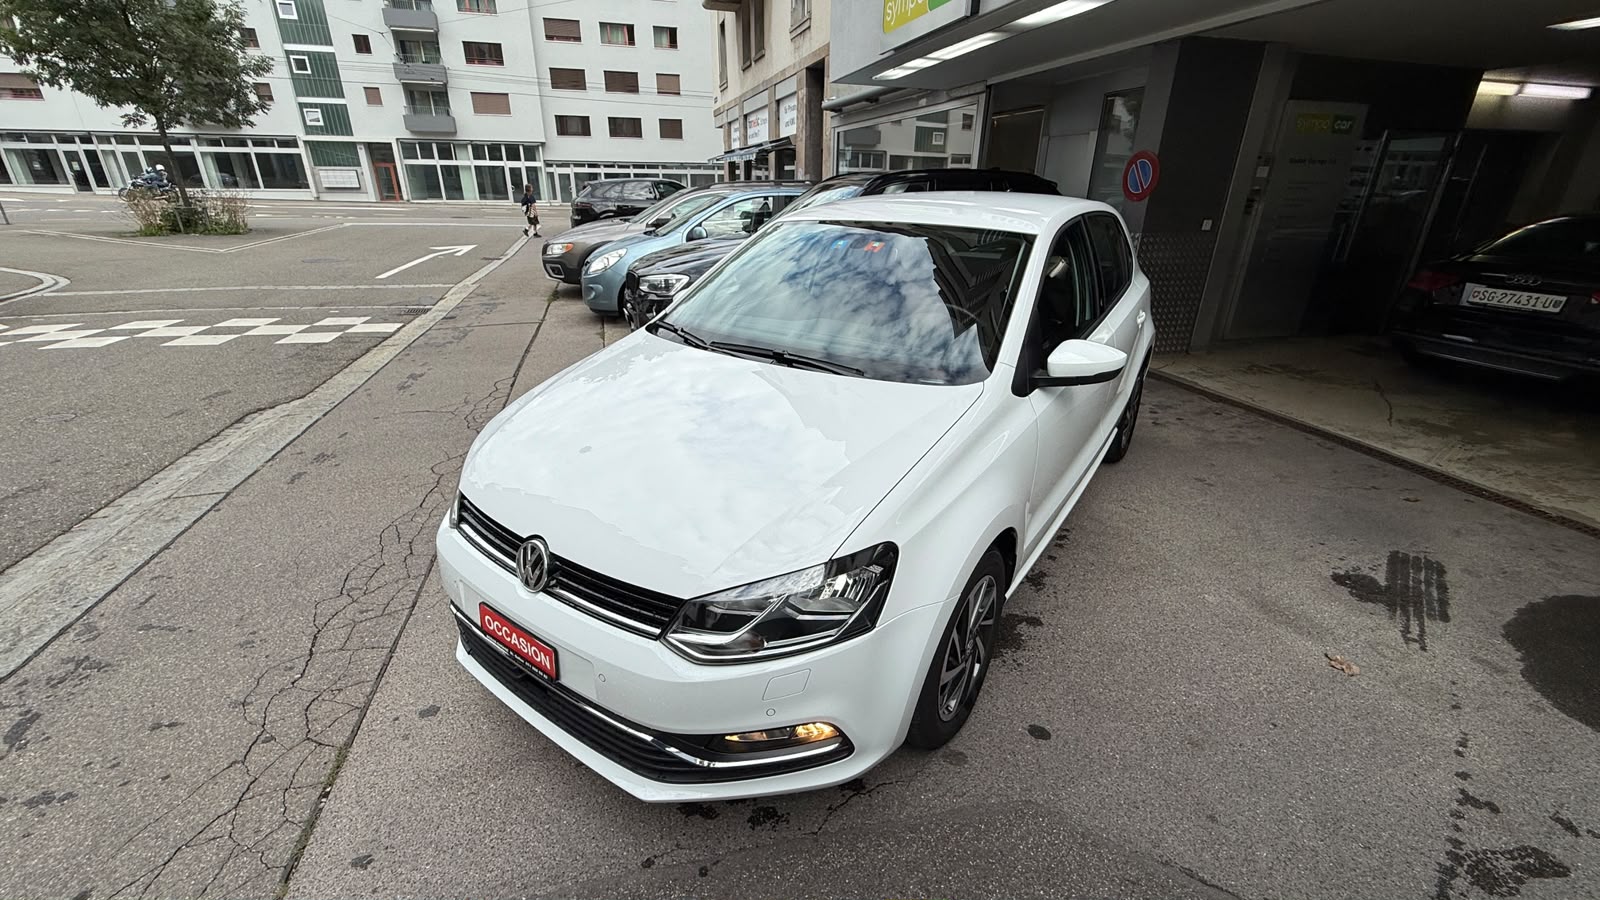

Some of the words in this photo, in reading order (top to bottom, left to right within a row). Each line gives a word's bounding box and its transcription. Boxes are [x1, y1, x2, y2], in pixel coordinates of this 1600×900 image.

[886, 0, 924, 25] symp
[1334, 120, 1353, 129] car
[484, 615, 551, 670] OCCASION
